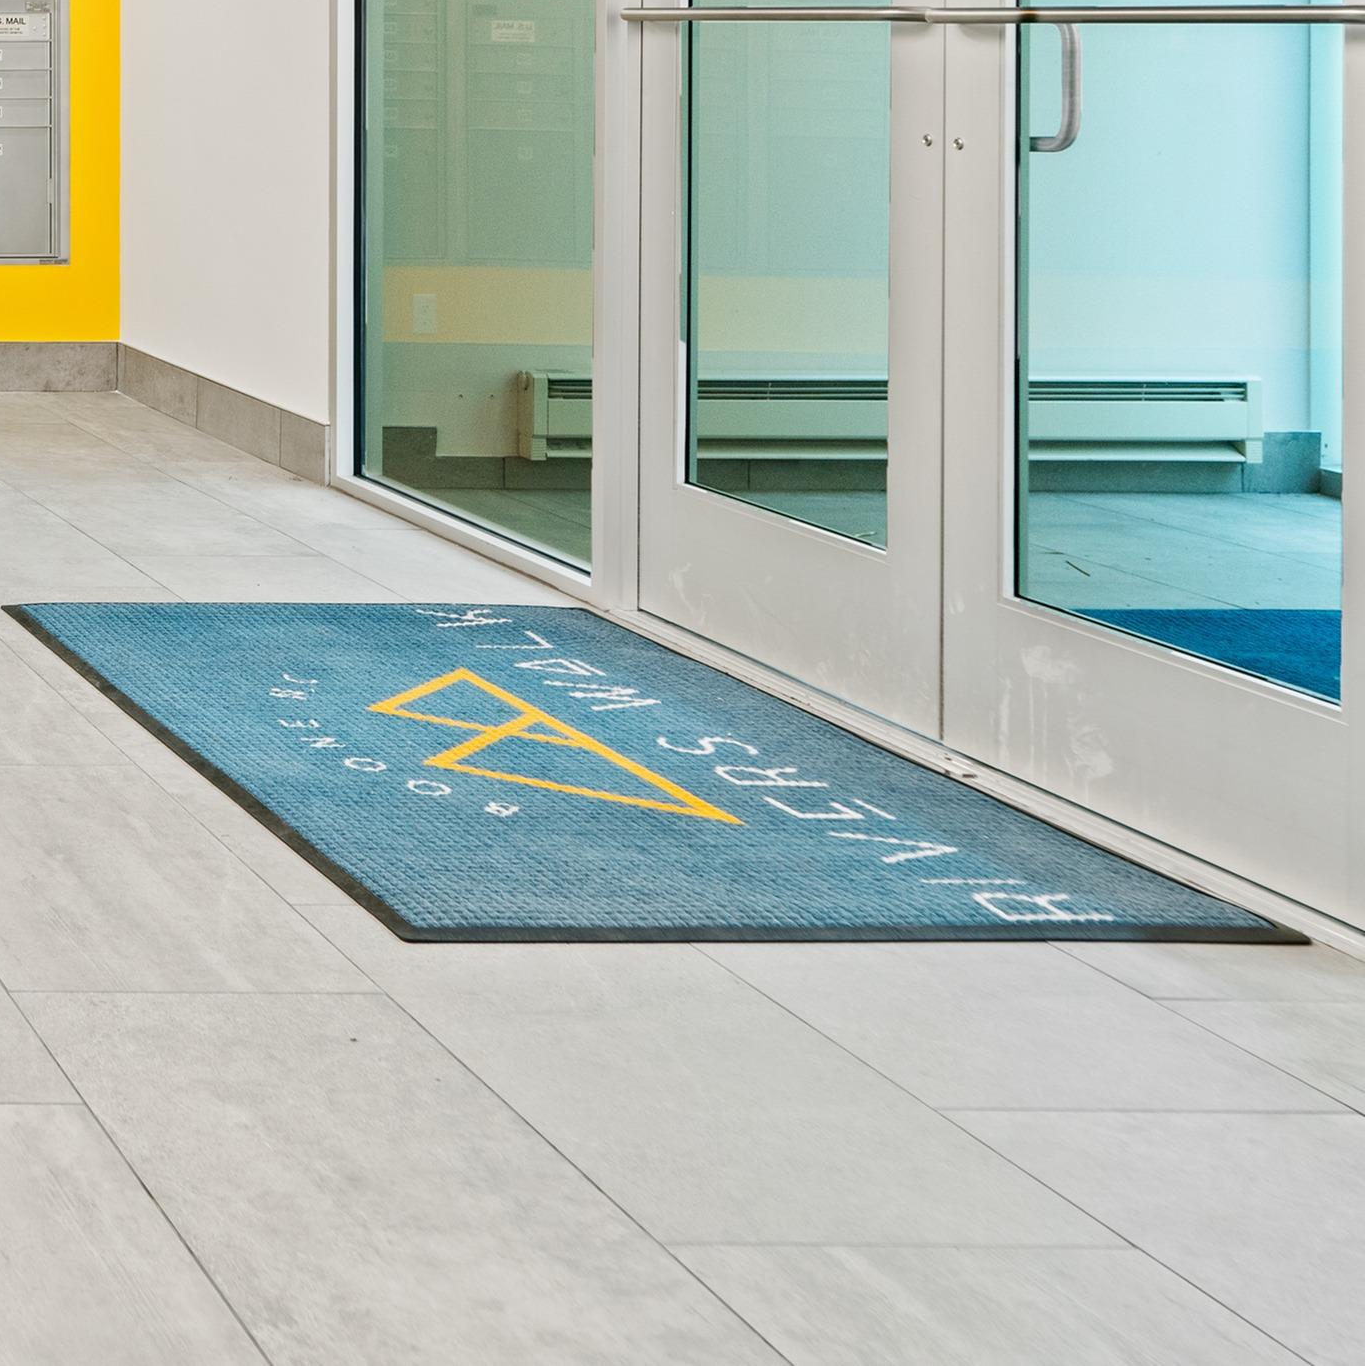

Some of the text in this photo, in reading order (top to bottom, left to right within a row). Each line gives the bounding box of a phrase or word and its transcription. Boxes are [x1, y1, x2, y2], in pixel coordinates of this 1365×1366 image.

[5, 17, 26, 25] MAIL
[278, 717, 520, 818] BOONE
[415, 608, 1115, 921] RIVERS WALK
